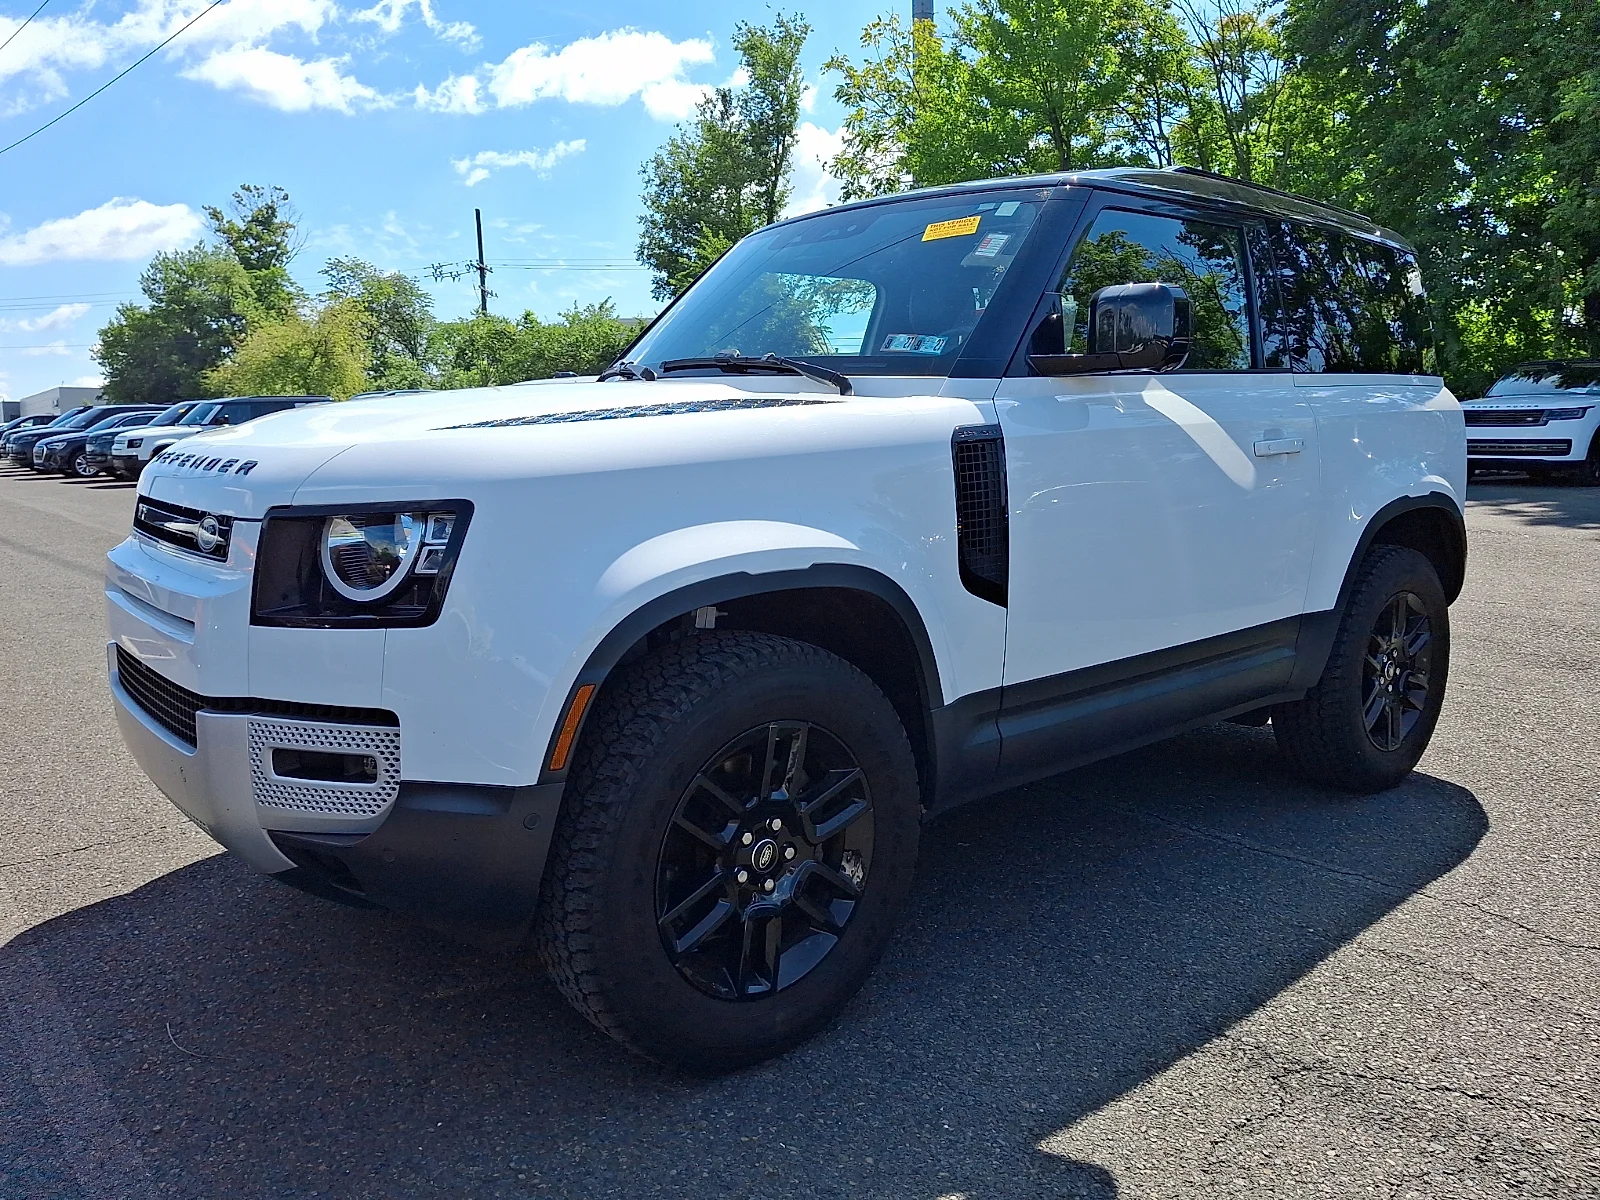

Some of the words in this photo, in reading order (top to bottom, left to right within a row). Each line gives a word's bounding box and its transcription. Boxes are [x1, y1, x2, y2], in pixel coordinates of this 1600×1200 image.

[947, 217, 977, 226] VEHICLE
[884, 338, 893, 349] 9
[903, 337, 915, 349] 27
[914, 339, 923, 351] 9
[933, 339, 945, 351] 27
